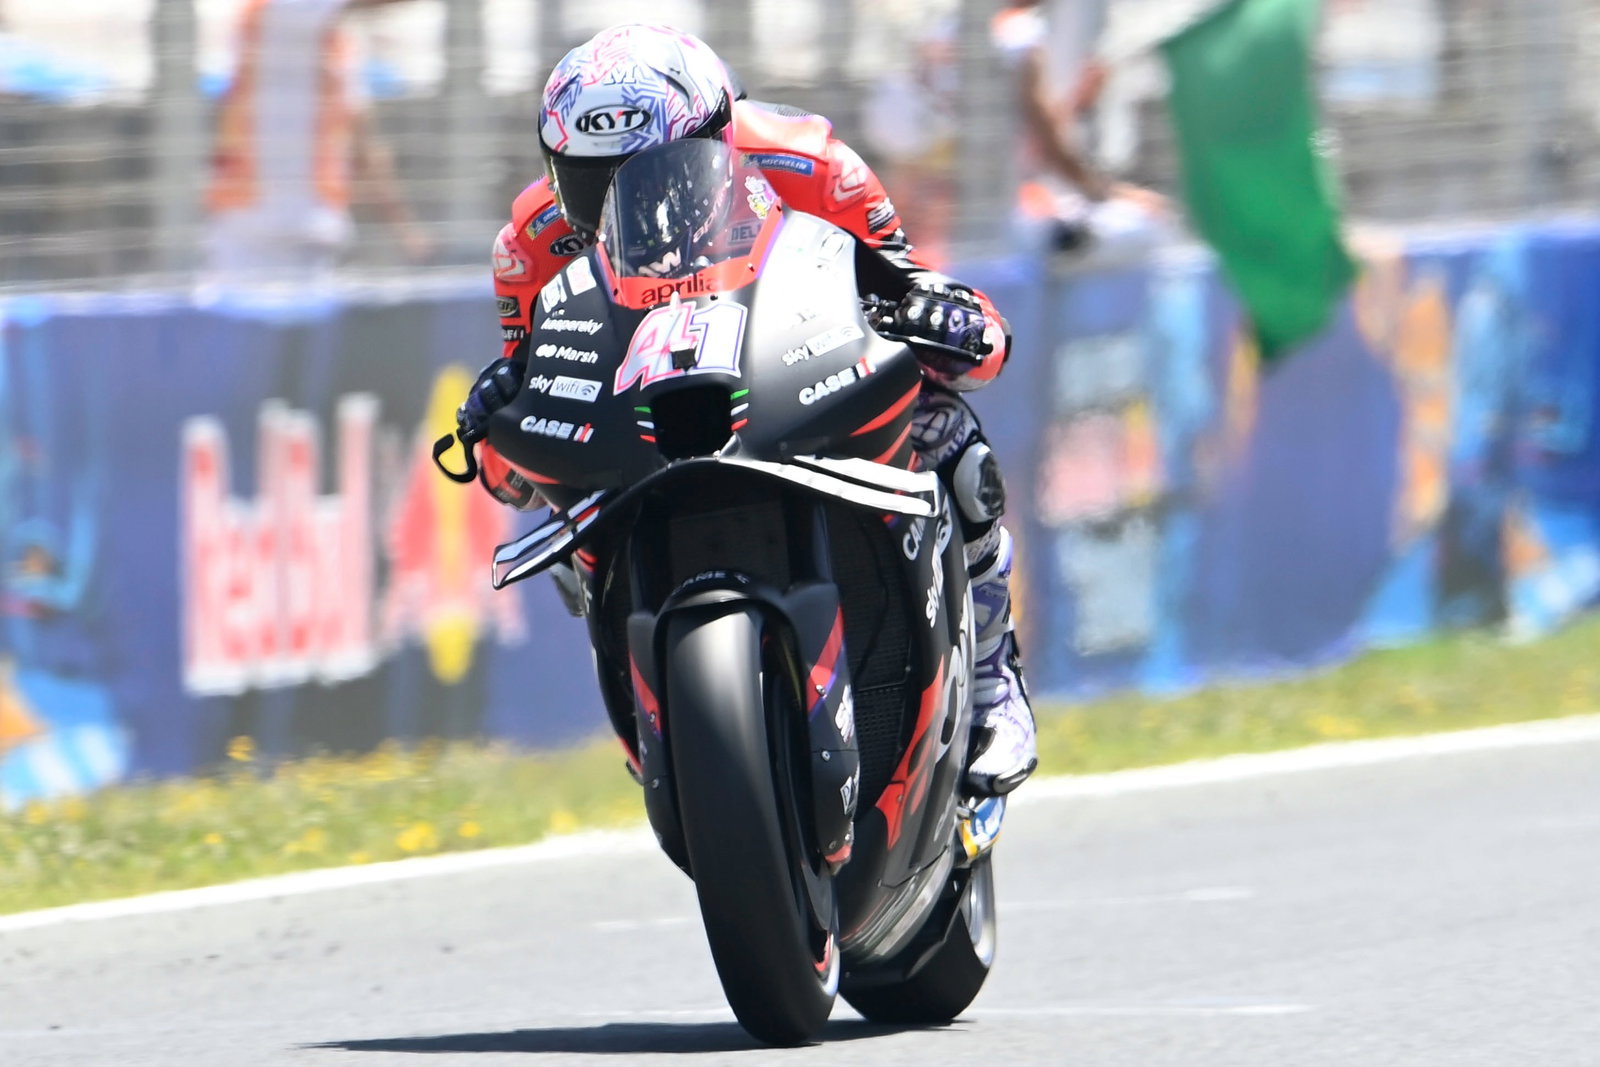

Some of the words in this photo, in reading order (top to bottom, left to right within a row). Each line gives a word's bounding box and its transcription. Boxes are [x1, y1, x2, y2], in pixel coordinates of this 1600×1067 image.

[577, 109, 648, 133] KYT
[641, 272, 719, 306] aprilia
[555, 345, 599, 364] Marsh
[613, 299, 748, 396] 41
[782, 344, 809, 367] sky
[528, 374, 553, 393] sky
[798, 367, 856, 405] CASE
[520, 415, 575, 440] CASE
